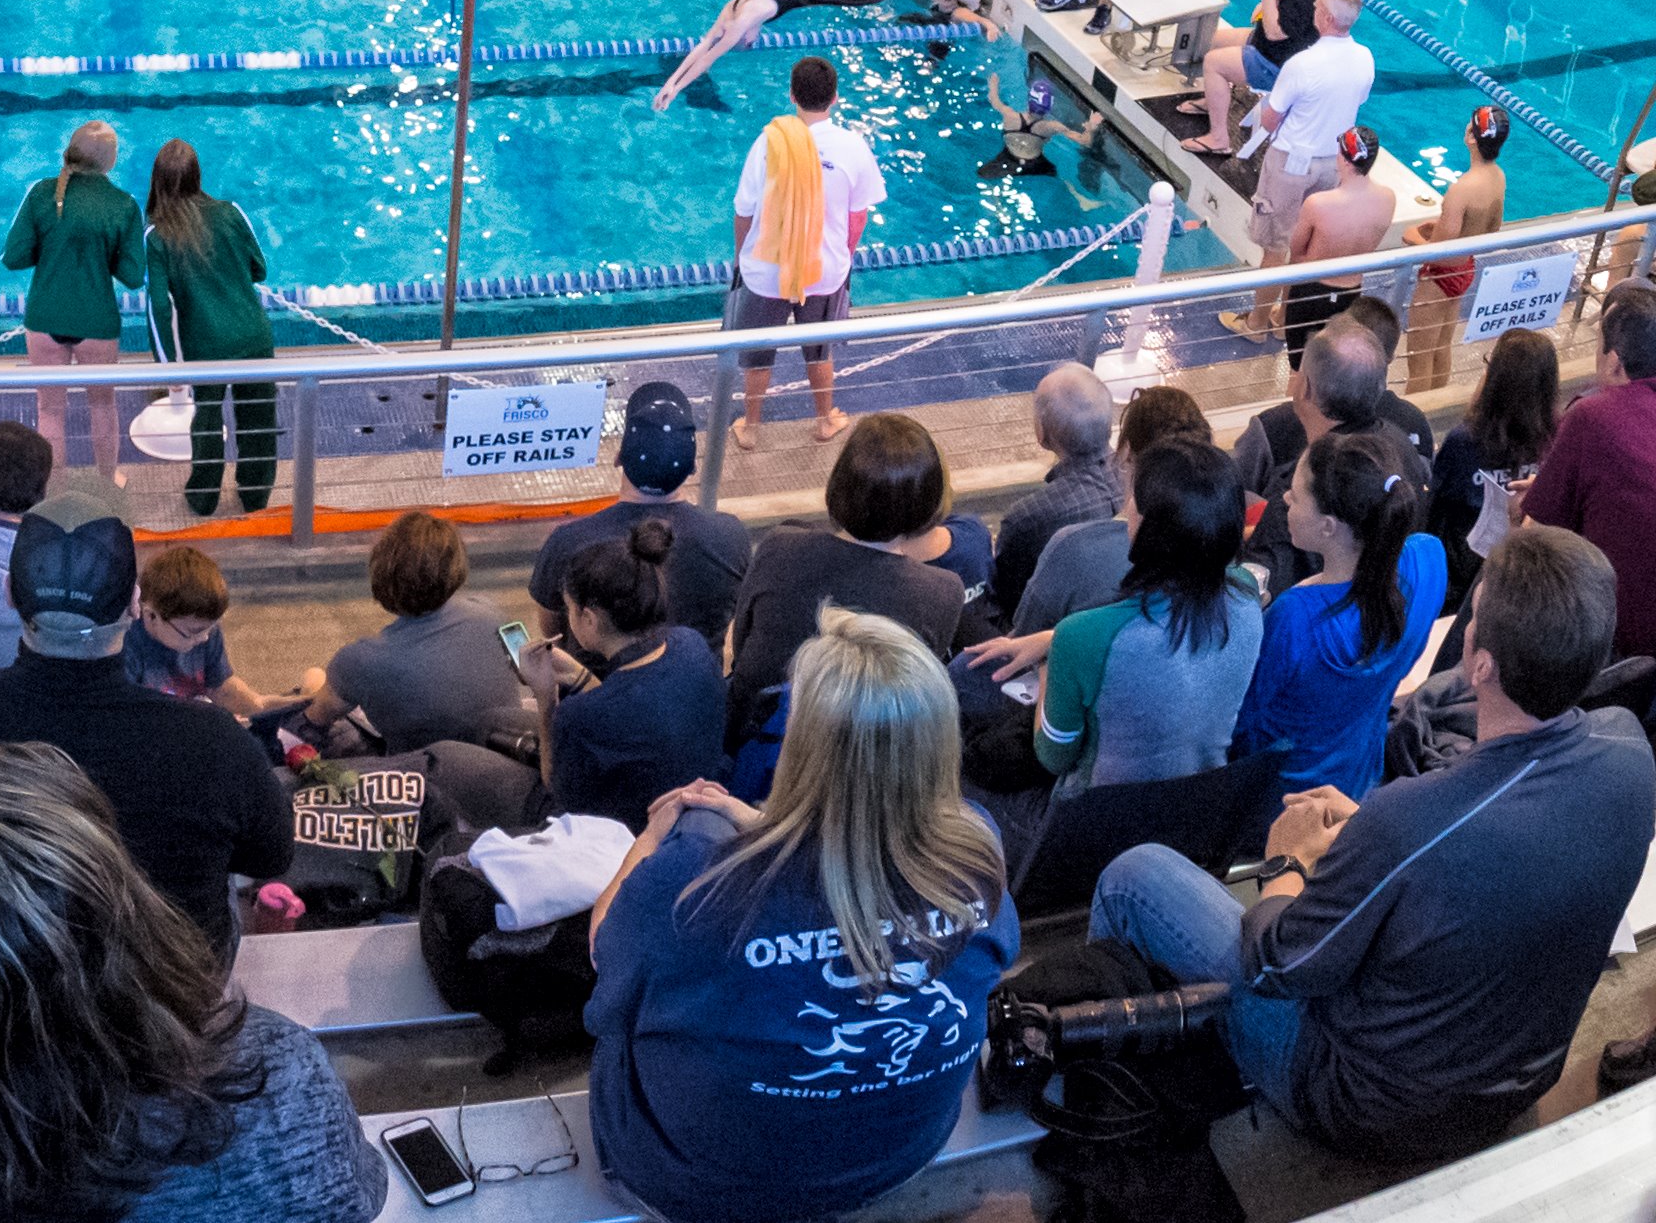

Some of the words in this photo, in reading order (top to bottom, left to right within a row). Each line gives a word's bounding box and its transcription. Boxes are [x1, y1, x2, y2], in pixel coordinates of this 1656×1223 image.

[1475, 299, 1526, 319] PLEASE
[1529, 292, 1562, 308] STAY
[1480, 318, 1506, 333] OFF
[1508, 310, 1547, 327] RAILS
[503, 409, 550, 422] FRISCO
[452, 430, 534, 449] PLEASE
[540, 426, 594, 443] STAY
[466, 451, 506, 466] OFF
[513, 446, 575, 463] RAILS
[294, 810, 420, 852] ARLETO
[745, 927, 849, 968] ONE
[750, 1081, 842, 1100] Setting
[851, 1080, 890, 1095] the
[897, 1069, 935, 1086] bar
